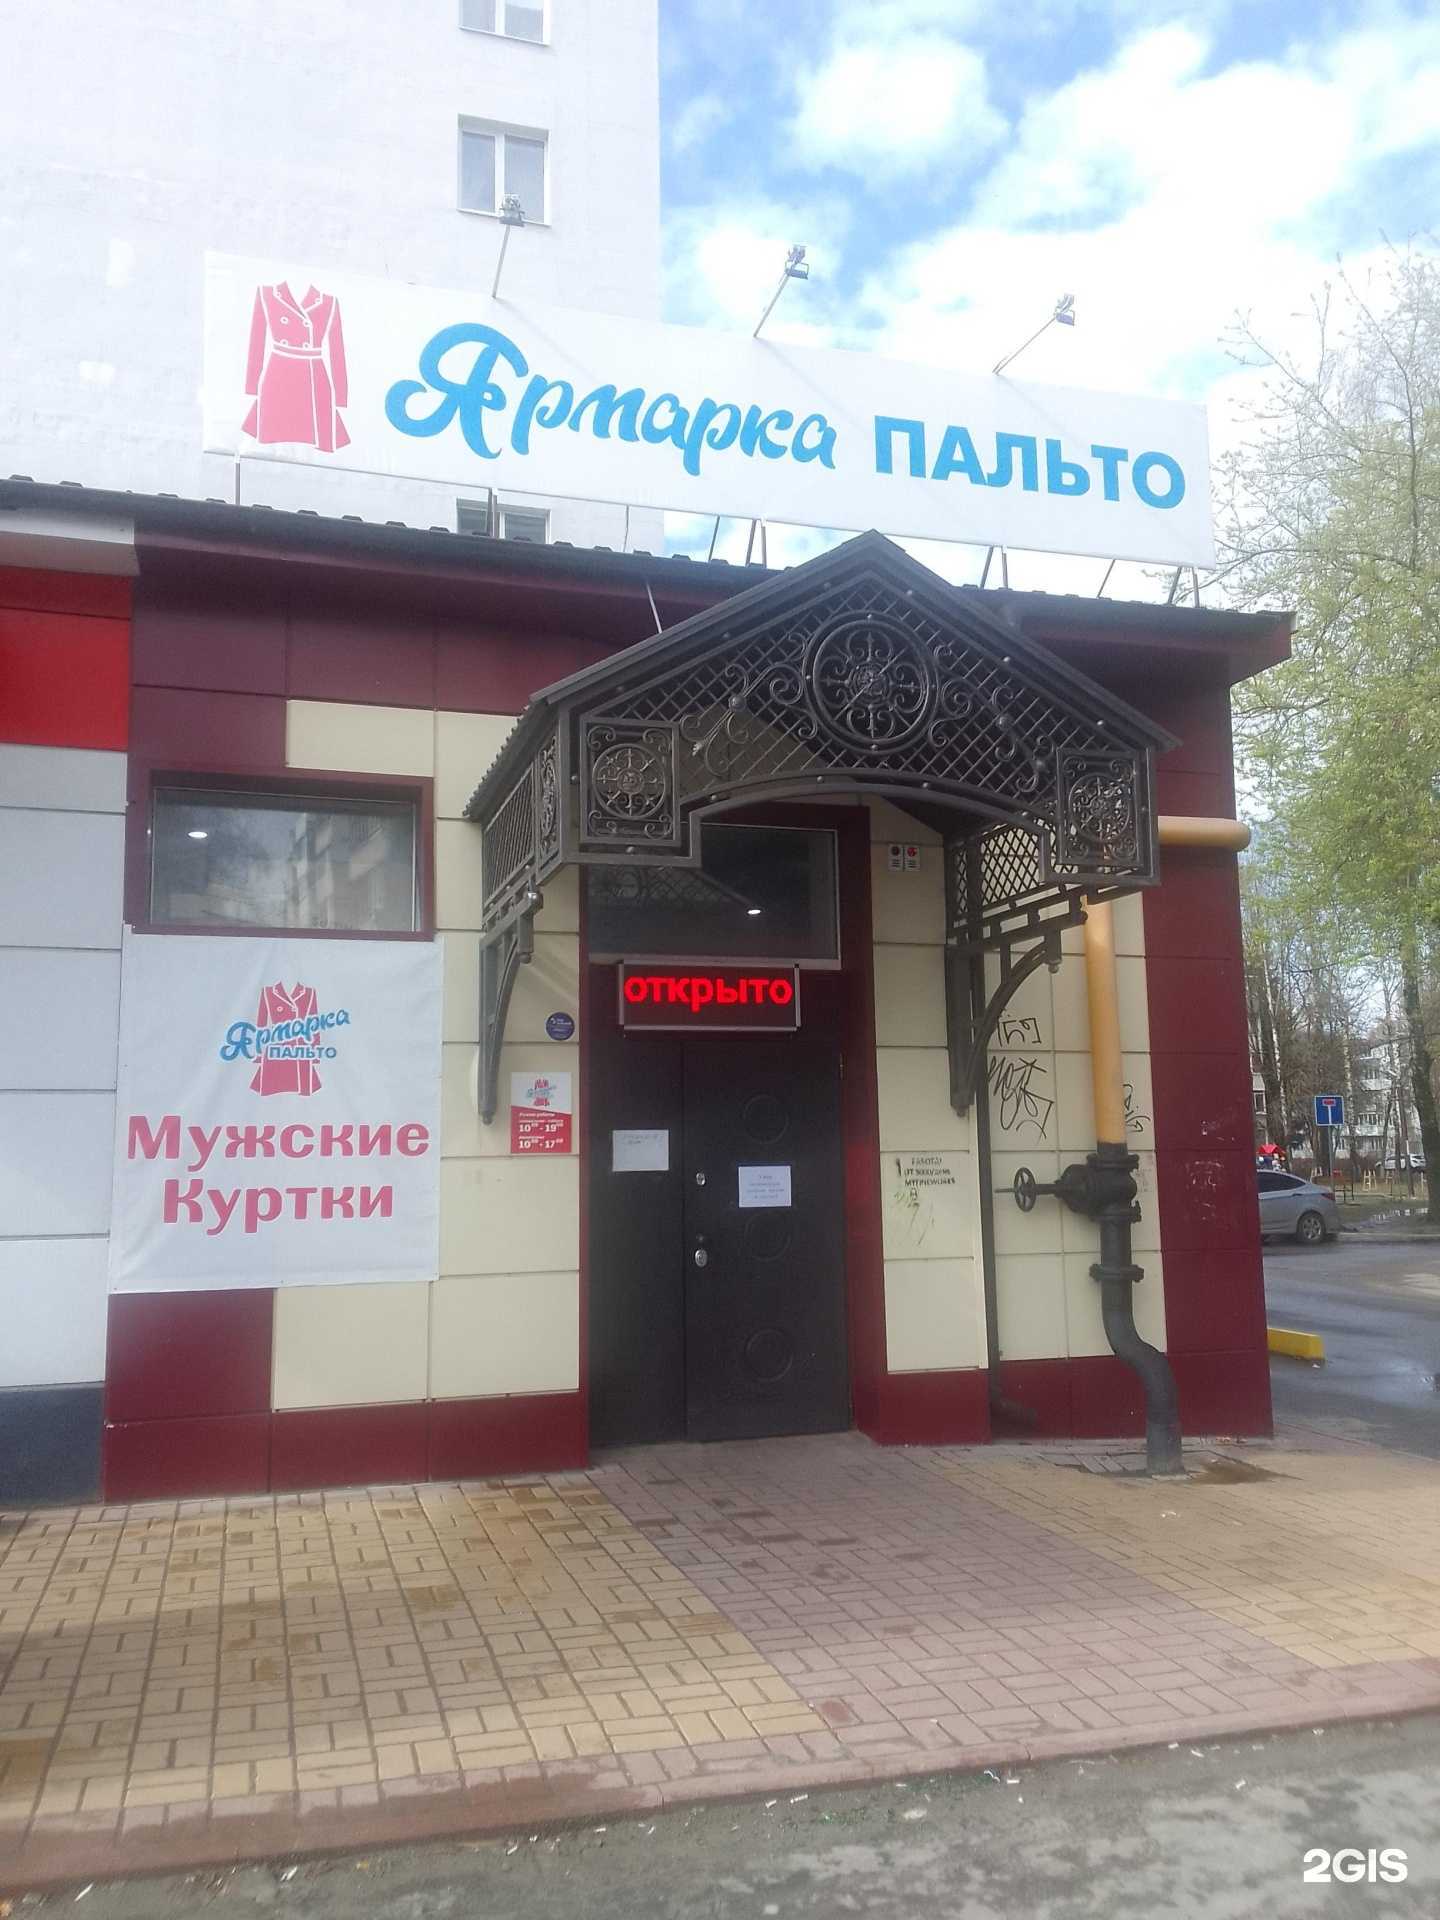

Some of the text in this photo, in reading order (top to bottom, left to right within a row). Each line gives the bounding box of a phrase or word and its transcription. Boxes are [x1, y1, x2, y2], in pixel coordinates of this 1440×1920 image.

[385, 323, 1186, 509] Ярмарка ПАЛЬТО
[625, 977, 793, 1013] открыто
[220, 1009, 351, 1061] Ярмарка
[268, 1046, 337, 1060] ПАЛЬТО
[128, 1115, 430, 1172] Мужские
[163, 1179, 393, 1235] Куртки
